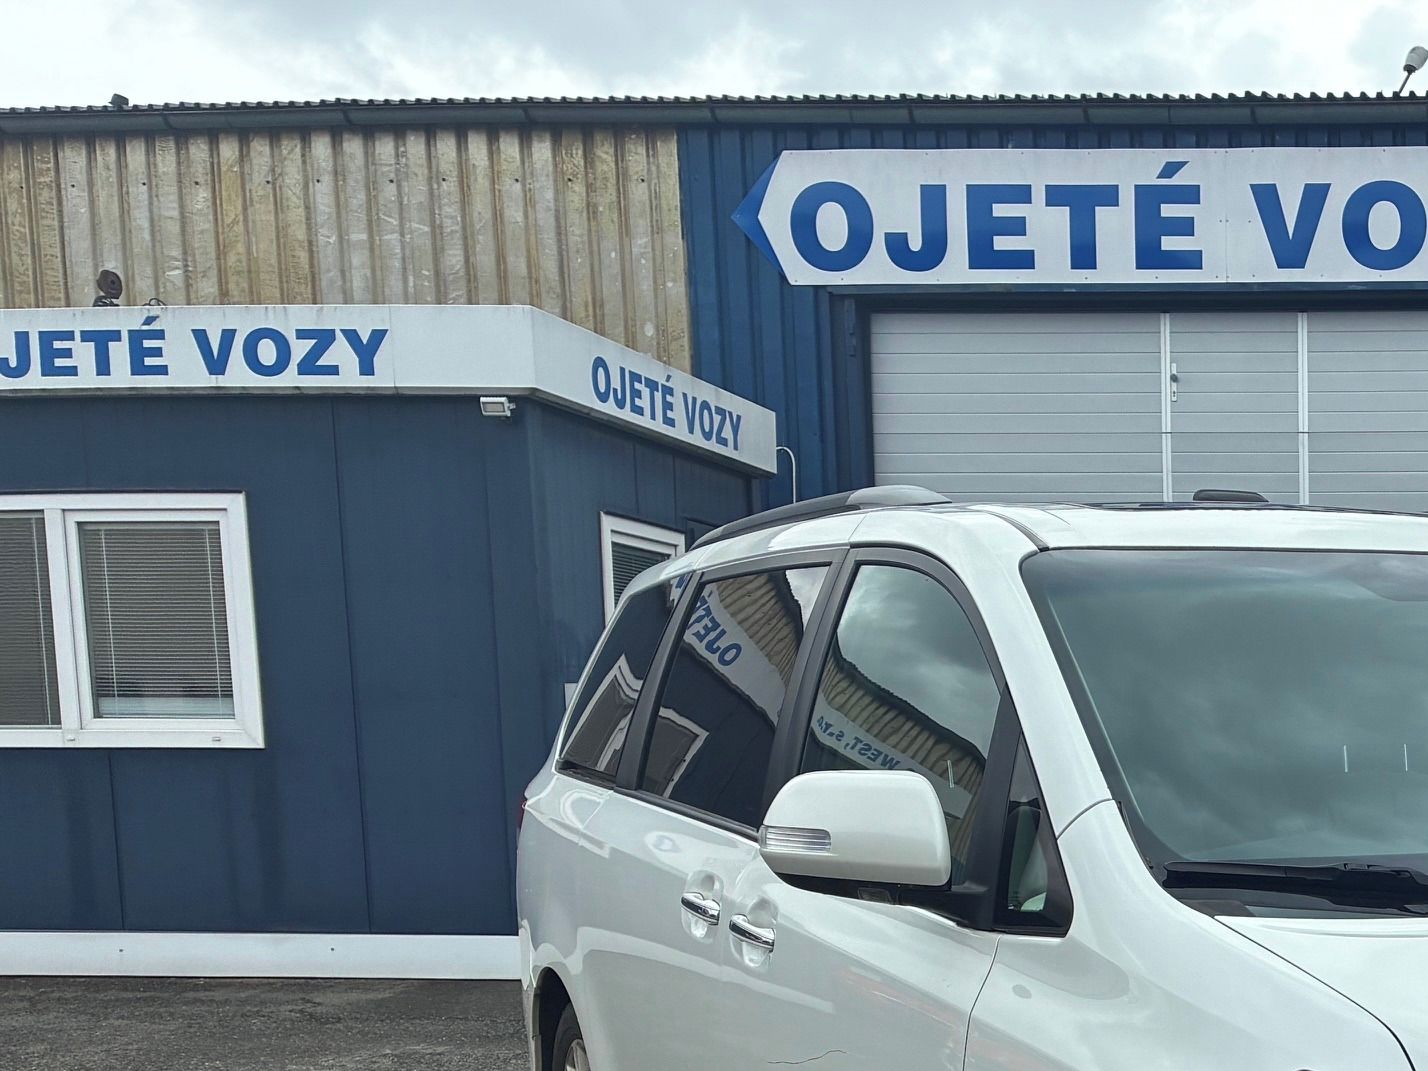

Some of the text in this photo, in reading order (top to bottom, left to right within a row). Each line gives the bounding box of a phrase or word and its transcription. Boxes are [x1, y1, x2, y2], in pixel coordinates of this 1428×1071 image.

[790, 160, 1203, 272] OJETÉ
[0, 316, 389, 379] JETÉ VOZY
[591, 355, 742, 451] OJETÉ VOZY
